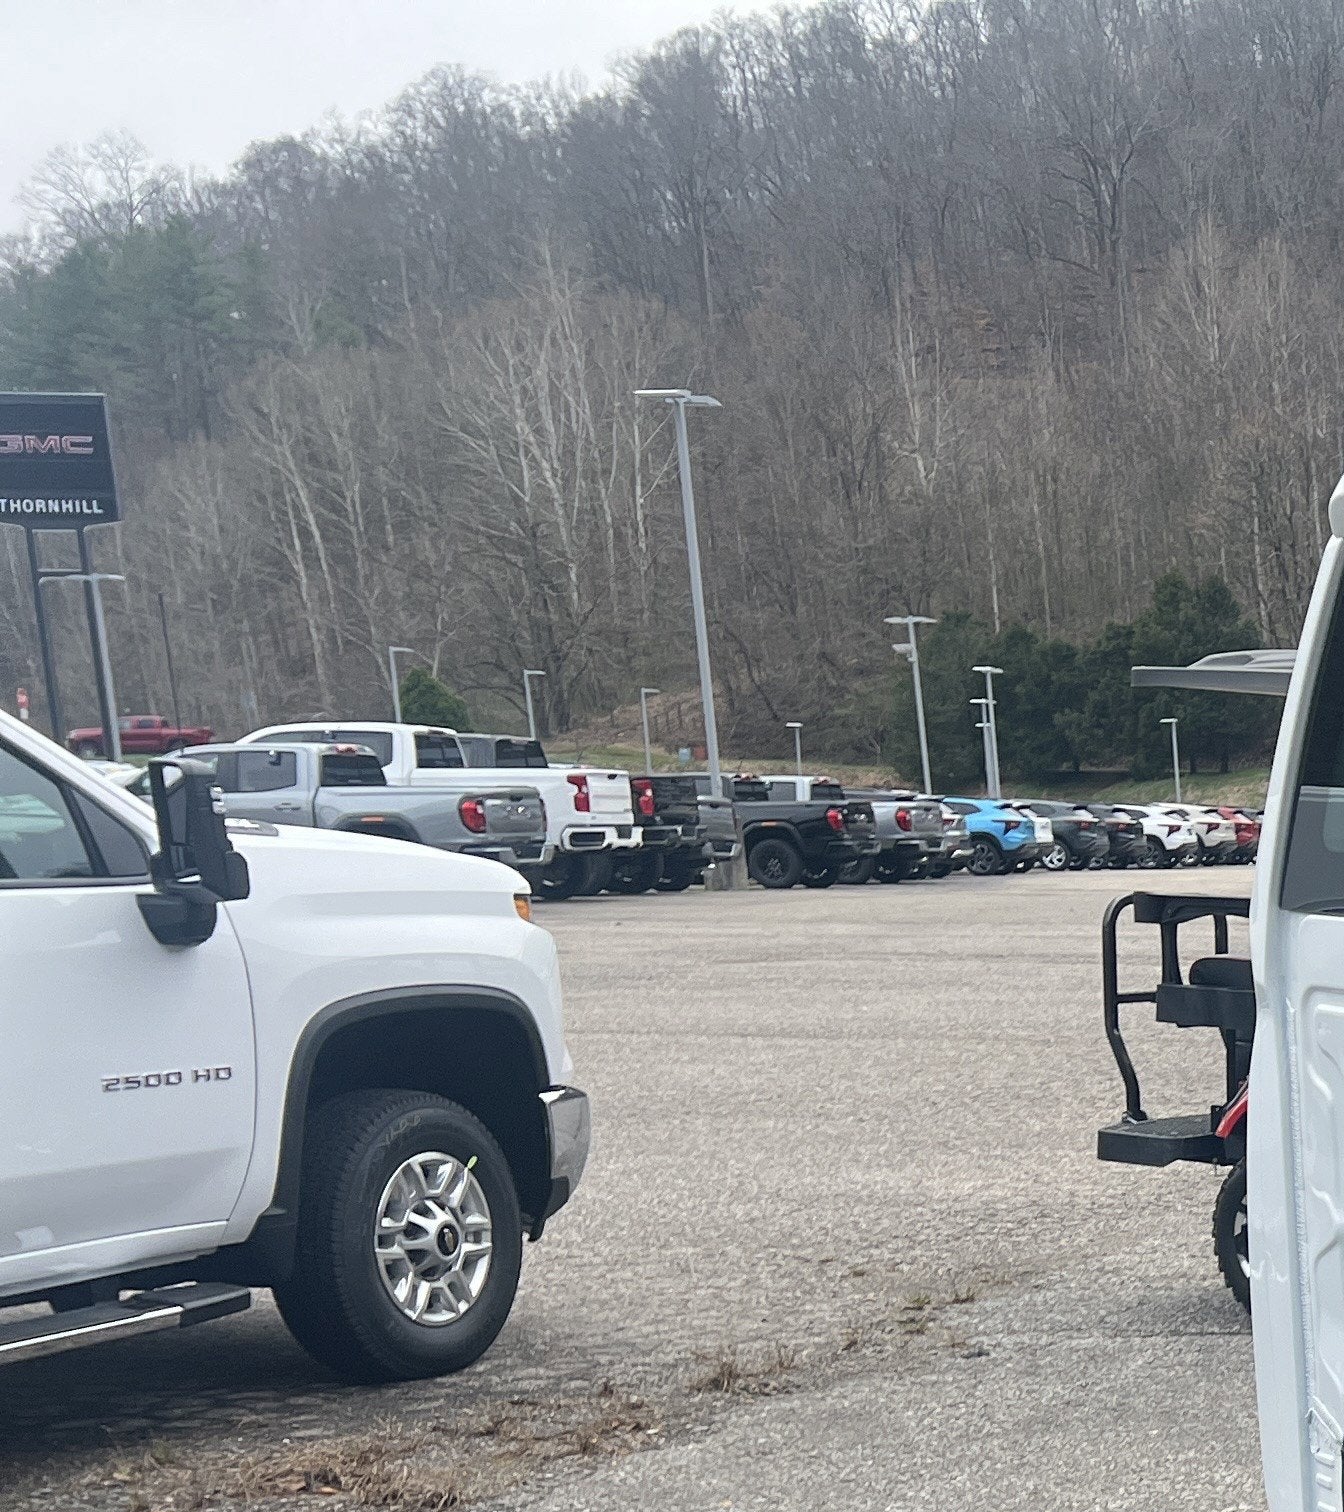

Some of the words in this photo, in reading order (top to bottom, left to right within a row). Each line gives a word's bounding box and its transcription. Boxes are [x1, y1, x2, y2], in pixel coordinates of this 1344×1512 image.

[0, 498, 104, 514] THORNHILL
[101, 1071, 182, 1092] 2500
[191, 1065, 232, 1084] HD
